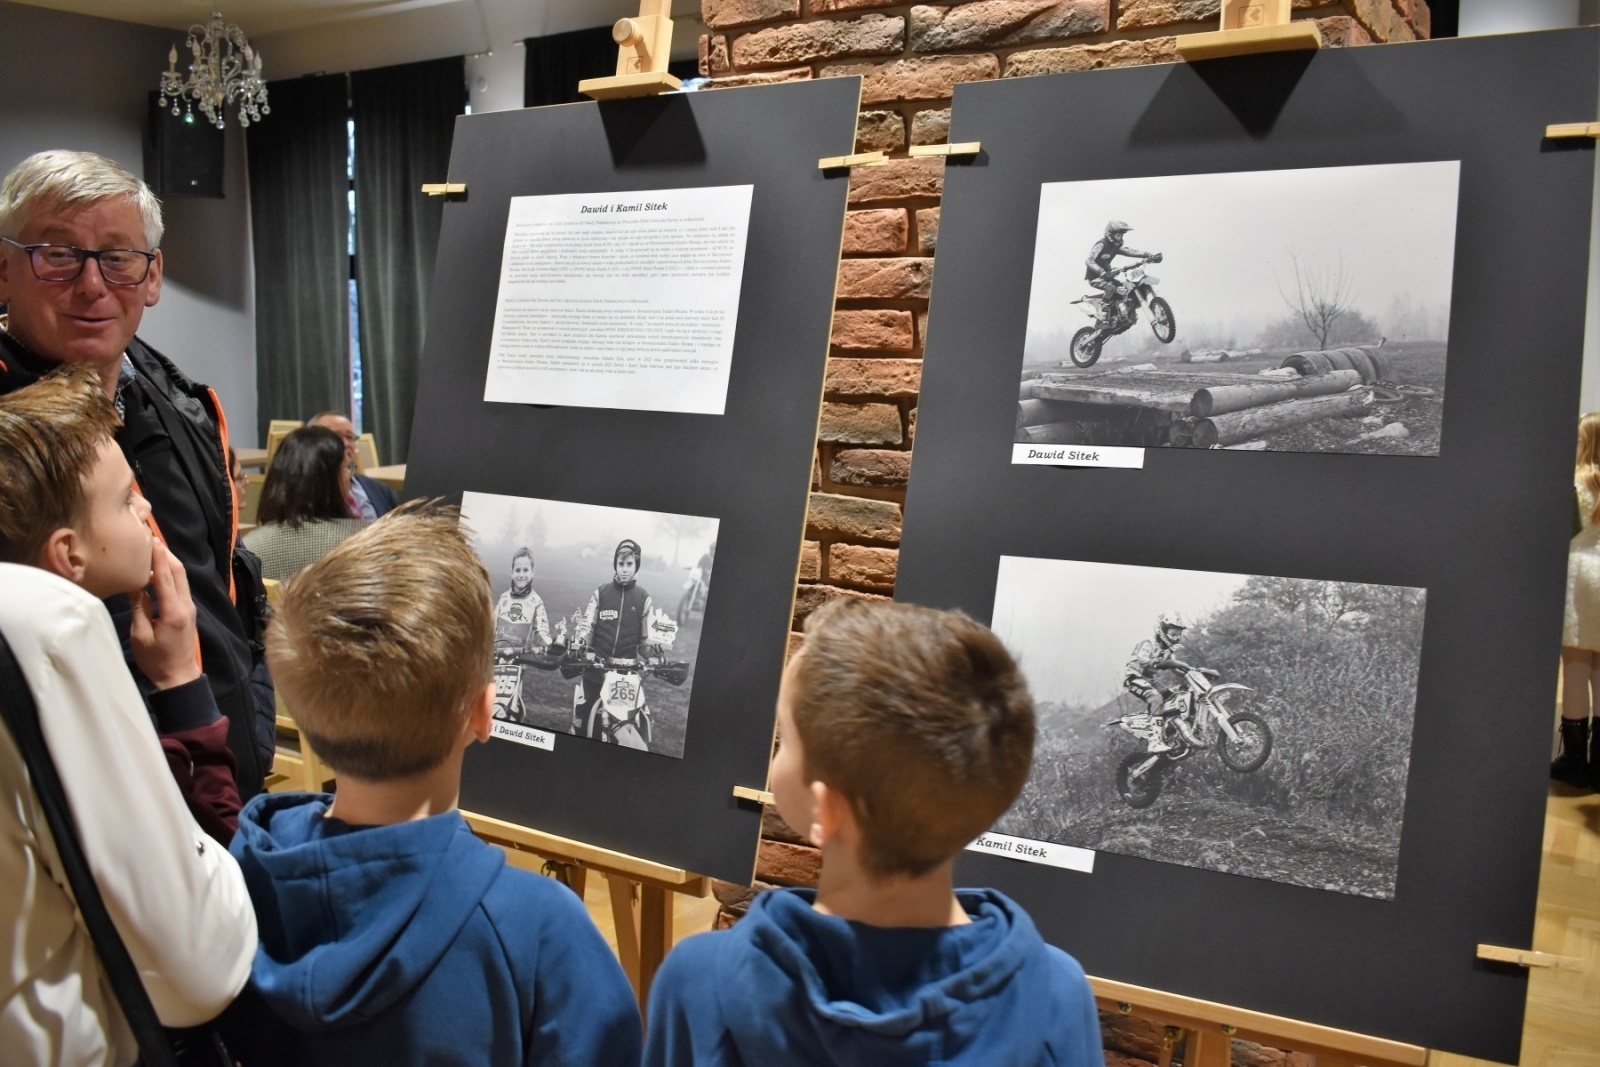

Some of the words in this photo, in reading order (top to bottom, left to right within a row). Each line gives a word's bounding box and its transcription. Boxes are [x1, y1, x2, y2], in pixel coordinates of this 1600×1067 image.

[580, 204, 608, 214] Dawid
[610, 204, 614, 213] i
[616, 203, 642, 213] Kamil
[644, 202, 668, 211] Sitek
[1027, 449, 1065, 459] Dawid
[1068, 450, 1100, 461] Sitek
[610, 688, 635, 701] 265
[499, 725, 524, 738] Dawid
[524, 732, 546, 744] Sitek
[976, 836, 1013, 851] Kamil
[1015, 843, 1048, 858] Sitek
